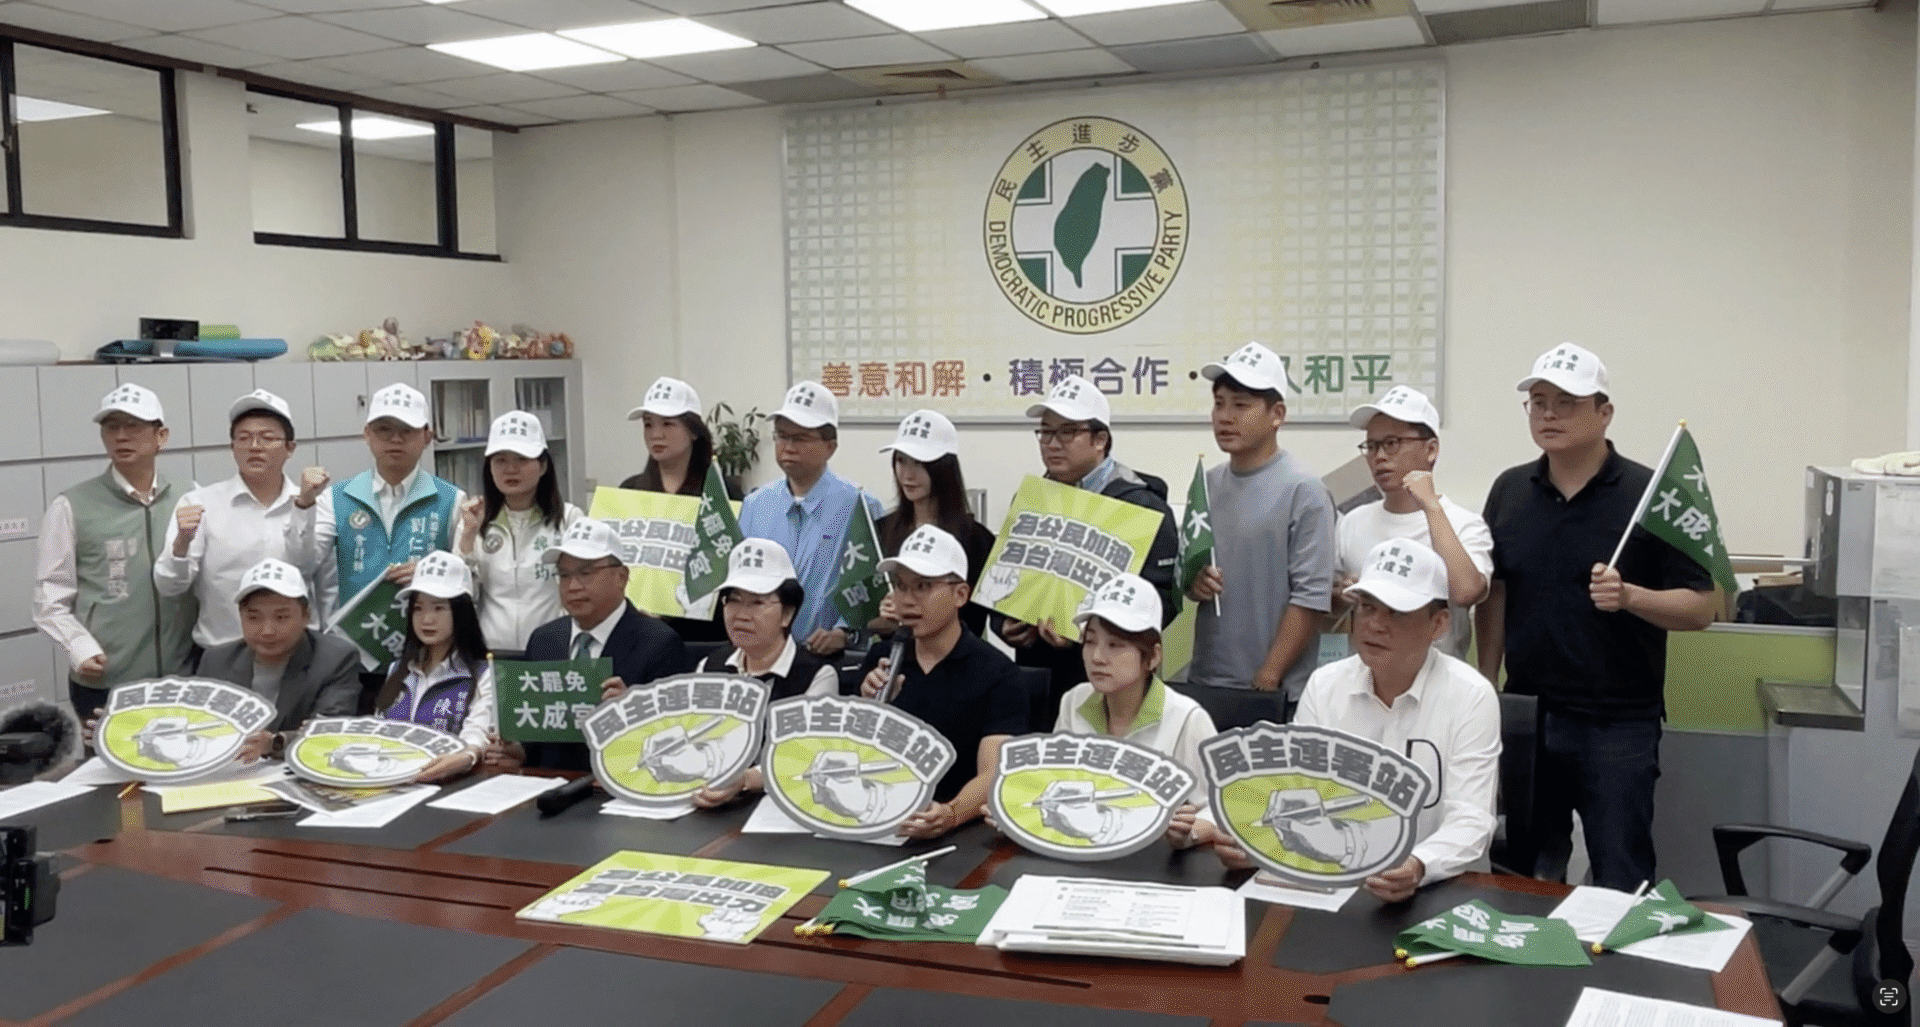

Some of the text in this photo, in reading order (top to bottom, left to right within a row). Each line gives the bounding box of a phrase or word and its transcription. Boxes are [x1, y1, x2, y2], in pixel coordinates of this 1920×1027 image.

[995, 124, 1174, 203] 民主進步黨
[989, 210, 1183, 328] DEMOCRATIC PROGRESSIVE PARTY
[1651, 488, 1713, 557] 大成
[514, 701, 596, 729] 大成宮
[518, 670, 587, 692] 大罷免
[593, 681, 763, 738] 民主連署站
[772, 703, 943, 777] 民主連署站
[1006, 739, 1189, 799] 民主連署站
[1210, 729, 1418, 804] 民主連署站
